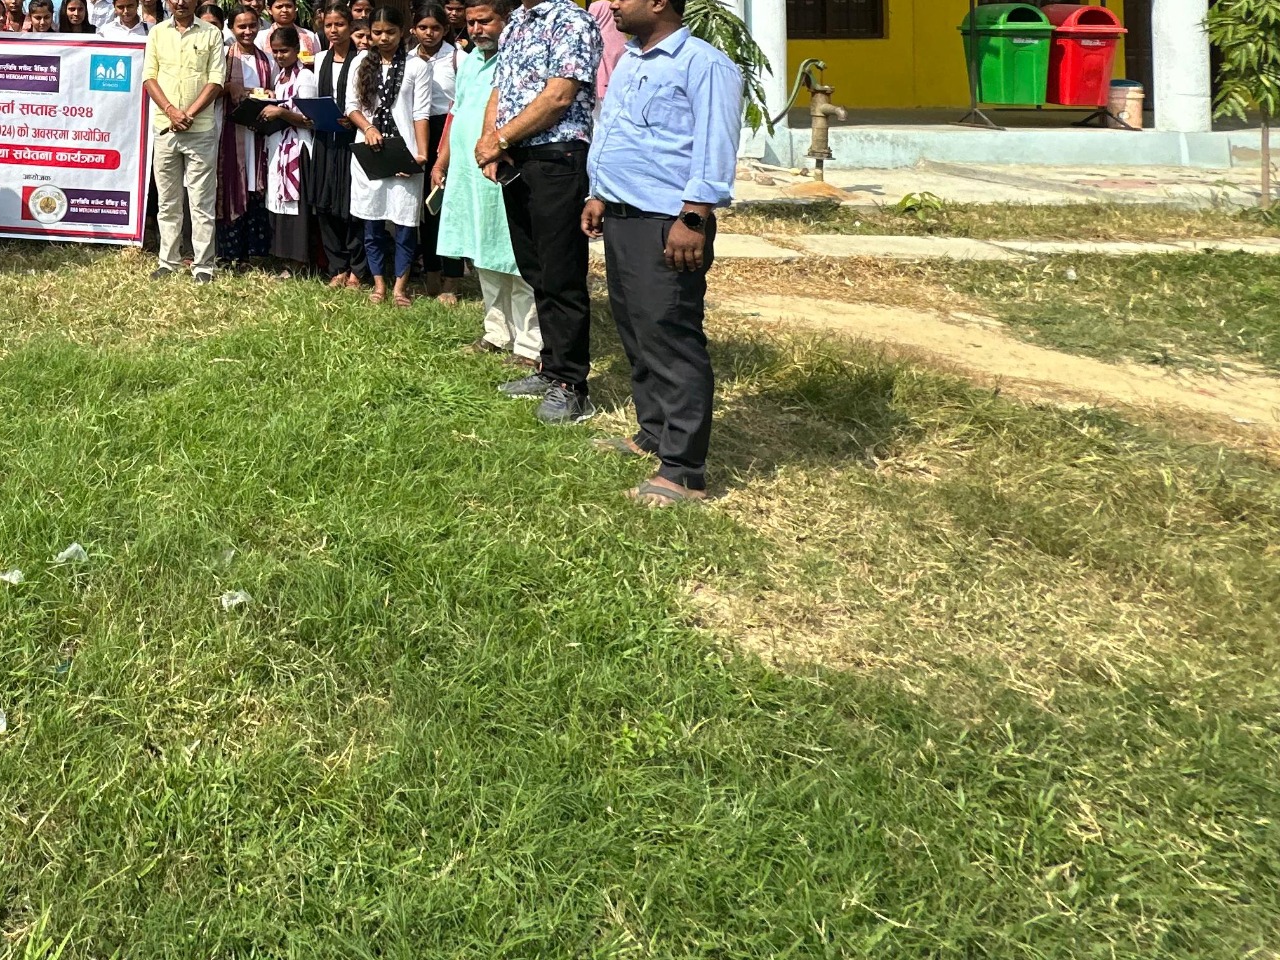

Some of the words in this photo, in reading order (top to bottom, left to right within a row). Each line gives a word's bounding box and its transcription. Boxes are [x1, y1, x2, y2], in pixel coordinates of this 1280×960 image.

[32, 128, 70, 140] अवसरमा
[72, 128, 111, 142] आयोजित
[13, 148, 52, 161] सचेतना
[56, 151, 106, 163] कार्यक्रम
